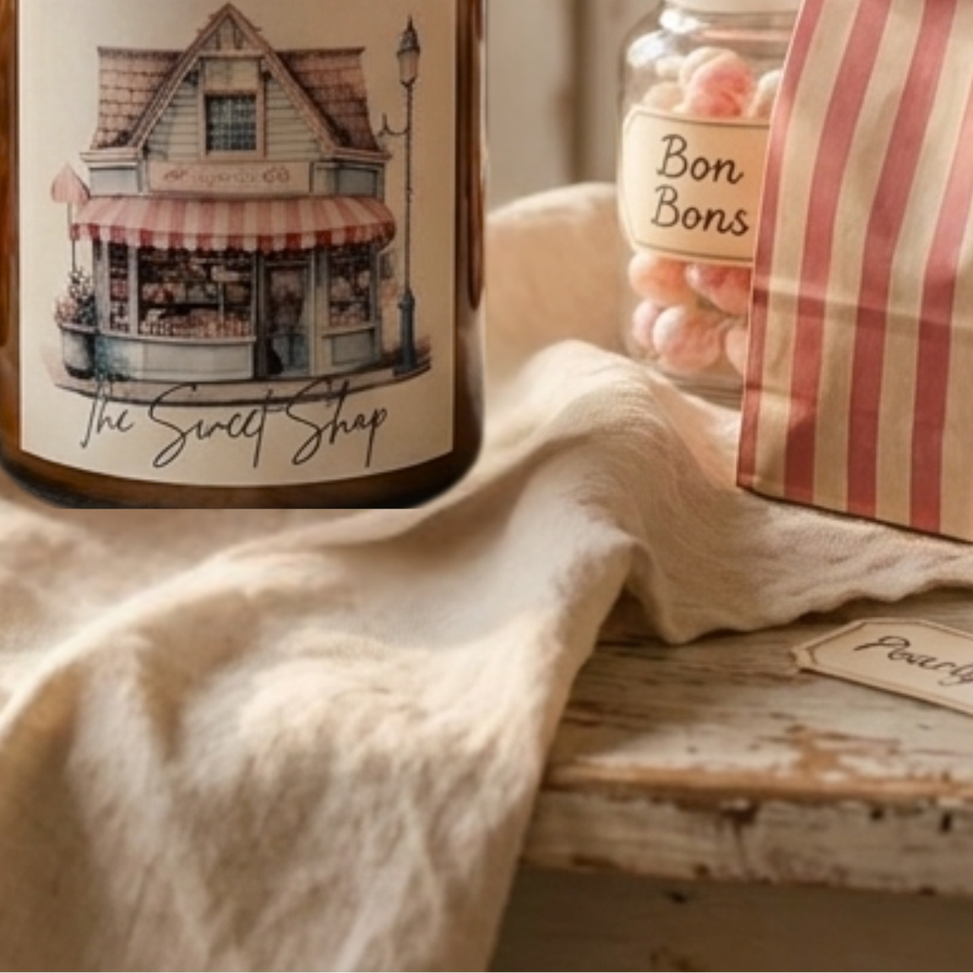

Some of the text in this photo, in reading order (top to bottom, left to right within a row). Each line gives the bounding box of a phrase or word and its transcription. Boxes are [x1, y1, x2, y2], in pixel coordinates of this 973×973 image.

[656, 133, 745, 185] Bon
[650, 184, 750, 237] Bons
[79, 377, 134, 449] The
[148, 382, 285, 468] Sweet
